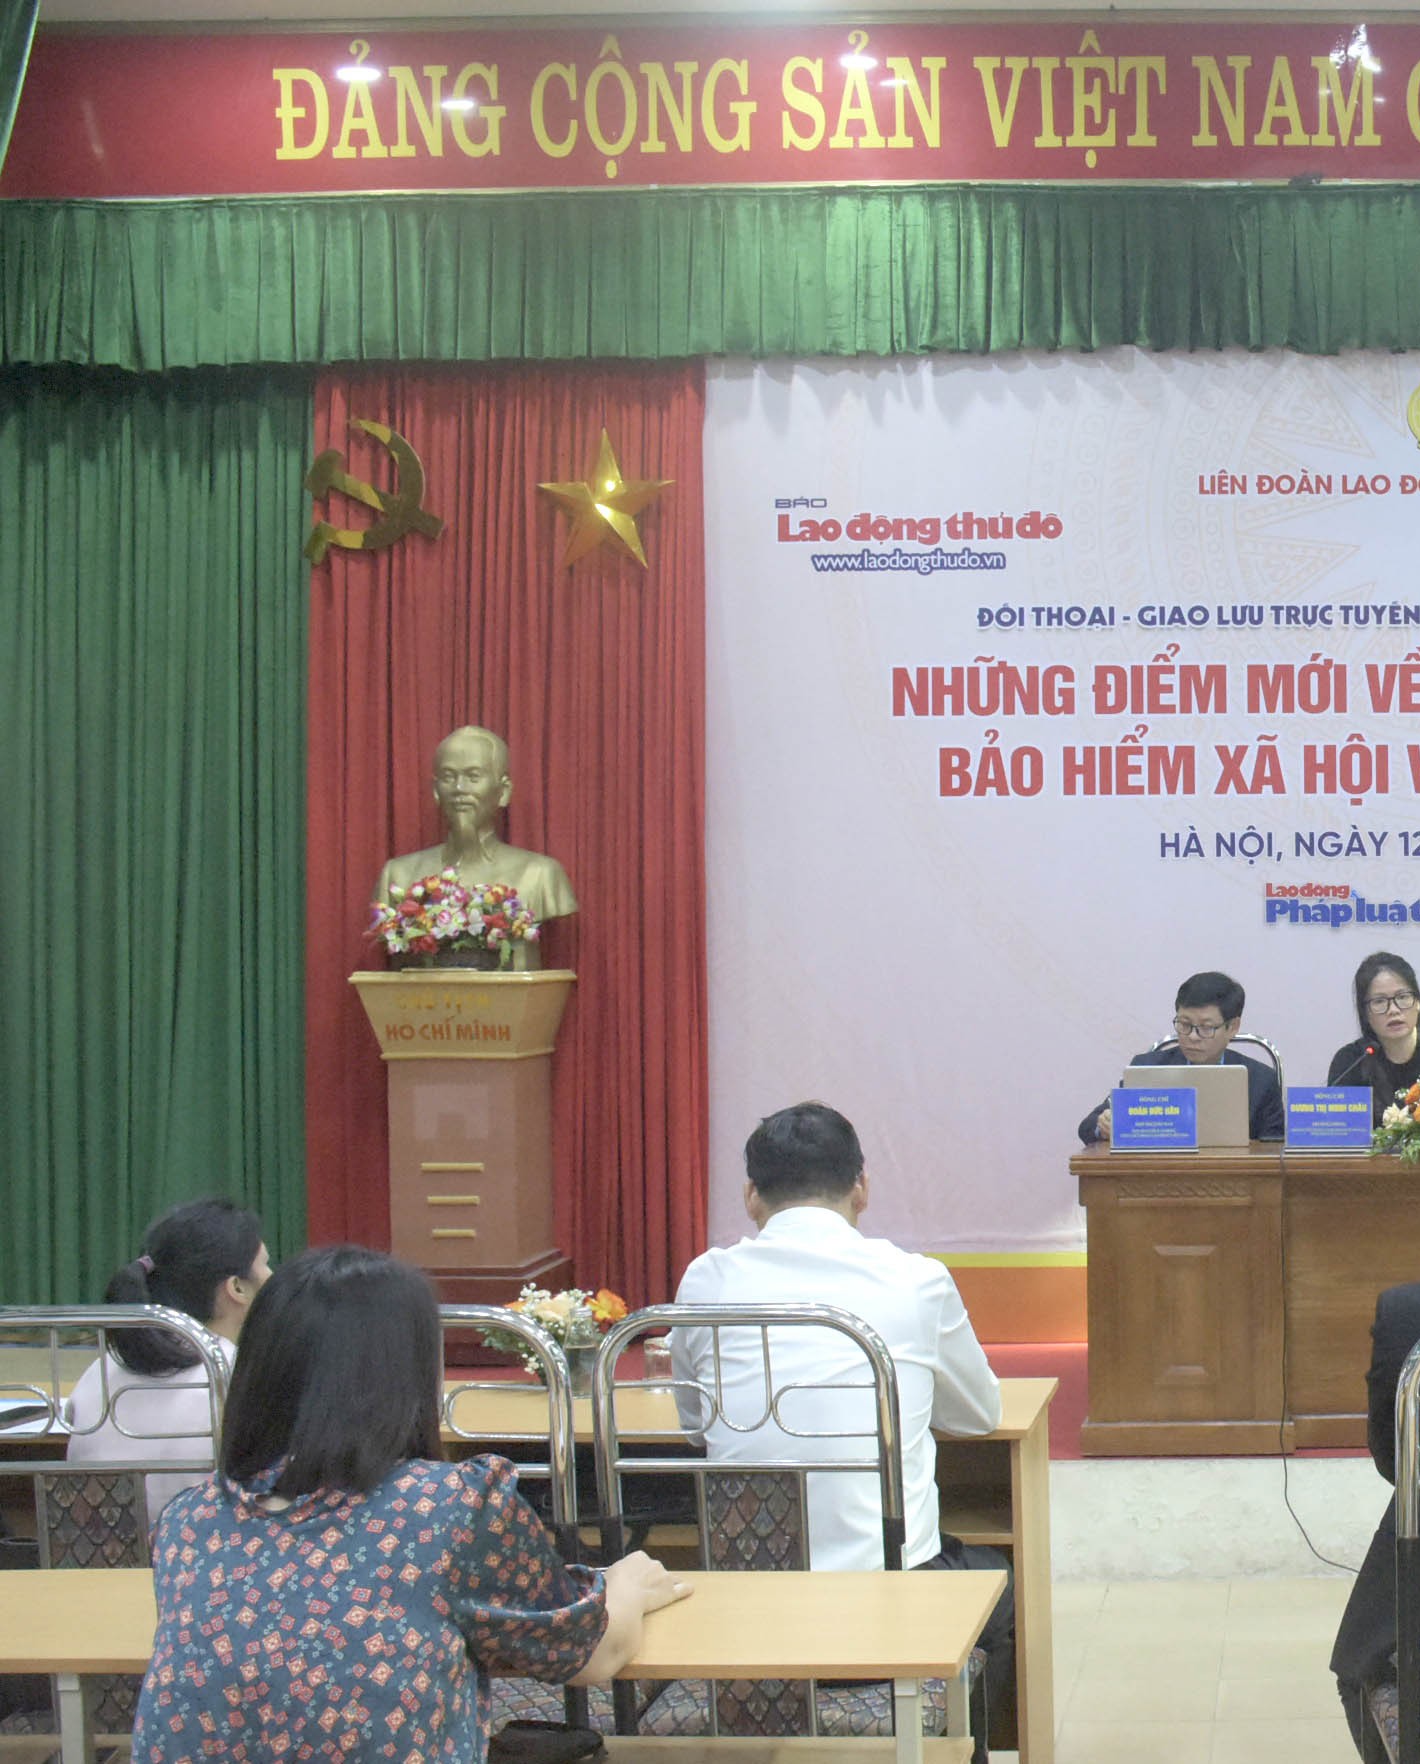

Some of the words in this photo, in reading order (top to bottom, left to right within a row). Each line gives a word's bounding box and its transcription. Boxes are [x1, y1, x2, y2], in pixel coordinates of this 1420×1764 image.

[272, 39, 507, 161] ĐẢNG
[530, 34, 757, 179] CỘNG
[781, 30, 942, 152] SẢN
[972, 29, 1167, 169] VIỆT
[1190, 54, 1382, 150] NAM
[1198, 469, 1248, 496] LIÊN
[1256, 468, 1332, 496] ĐOÀN
[1341, 474, 1391, 496] LAO
[778, 514, 843, 542] Lao
[846, 512, 941, 546] động
[943, 511, 1014, 540] thủ
[1016, 510, 1064, 539] đô
[812, 548, 1006, 575] www.laodongthudo.vn
[1031, 605, 1116, 628] THOẠI
[1137, 605, 1210, 626] GIAO
[1217, 604, 1265, 627] LƯU
[1270, 604, 1334, 628] TRỰC
[892, 655, 1076, 717] NHỮNG
[1092, 643, 1228, 716] ĐIỂM
[1247, 653, 1348, 714] MỚI
[939, 728, 1044, 797] BẢO
[1063, 723, 1196, 796] HIỂM
[1214, 735, 1286, 795] XÃ
[1303, 732, 1390, 806] HỘI
[1160, 825, 1205, 858] HÀ
[1215, 825, 1283, 865] NỘI,
[1294, 824, 1389, 858] NGÀY
[1265, 882, 1299, 898] Lao
[1265, 898, 1353, 928] Pháp
